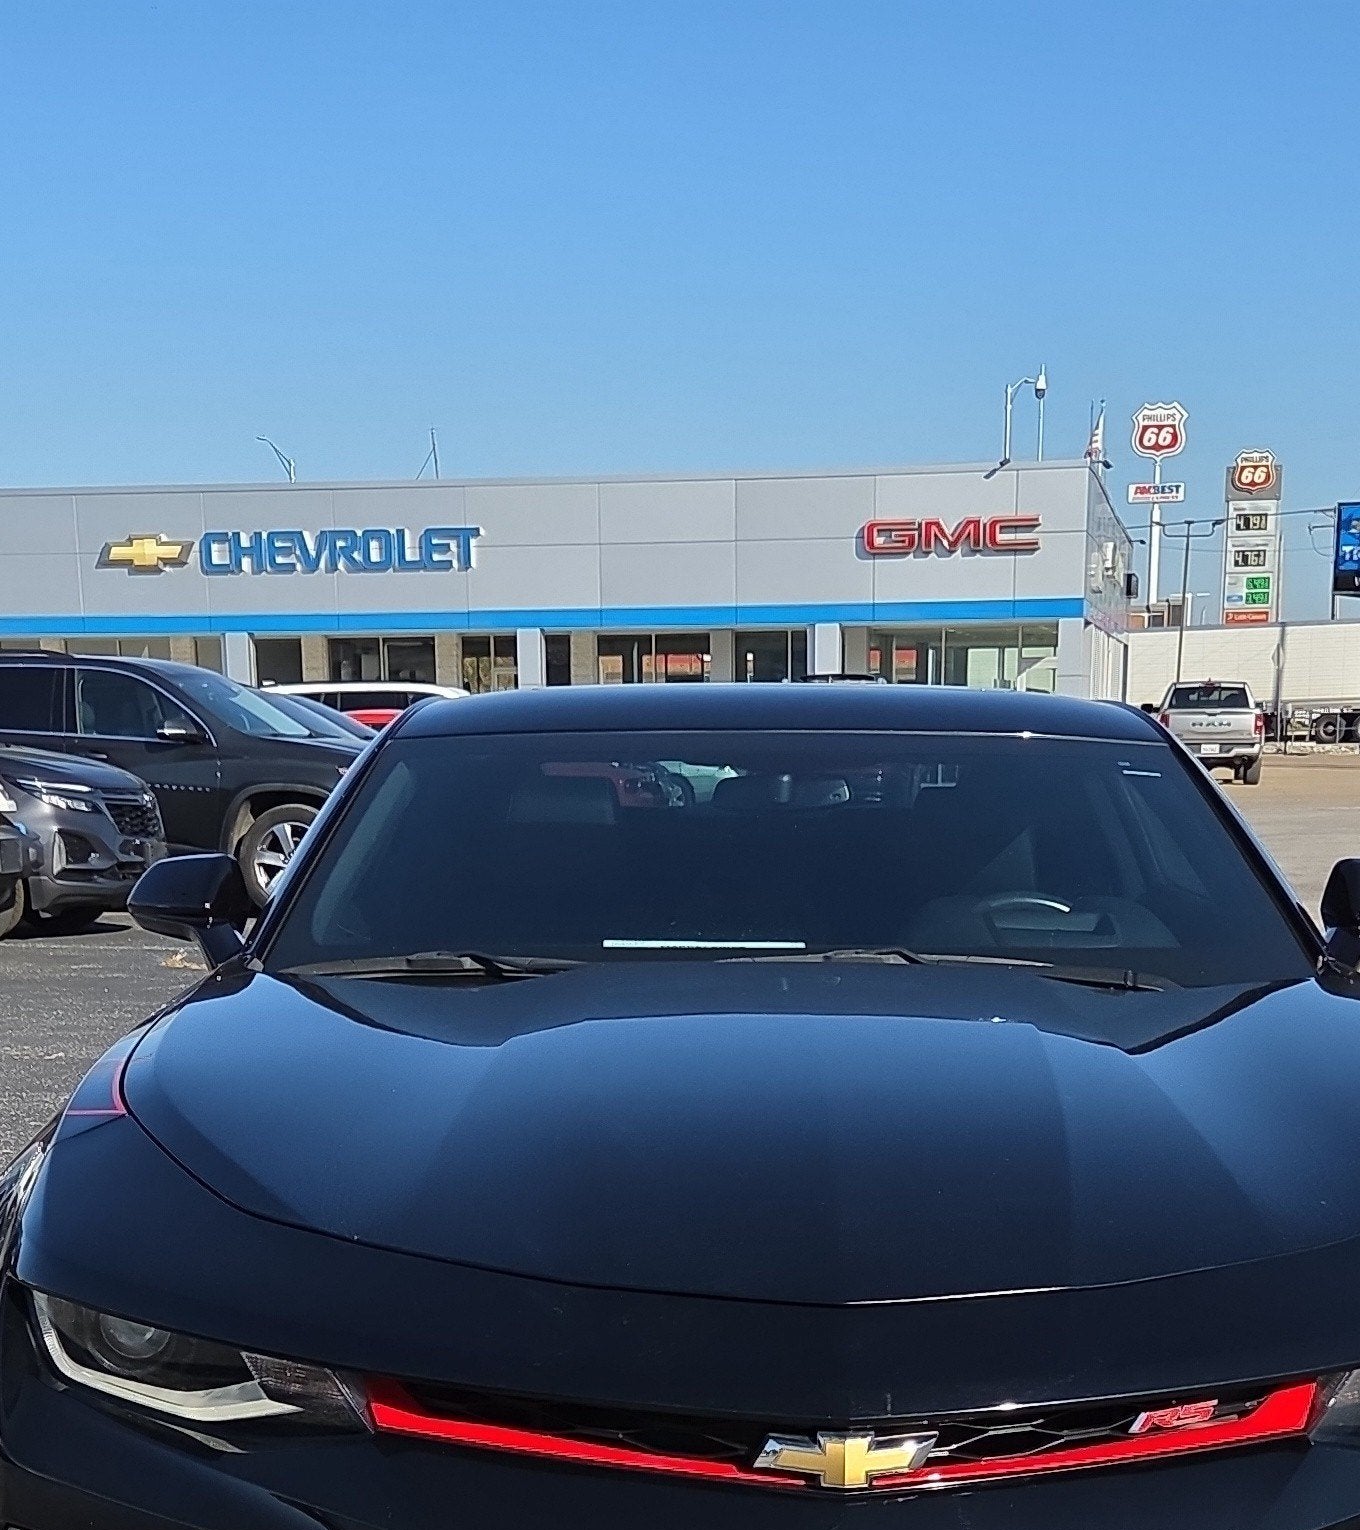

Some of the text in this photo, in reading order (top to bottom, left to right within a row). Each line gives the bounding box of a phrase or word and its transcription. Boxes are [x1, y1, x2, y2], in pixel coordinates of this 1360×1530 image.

[1142, 413, 1177, 423] PHILLIPS
[1142, 427, 1174, 447] 66
[1241, 467, 1268, 483] 66
[862, 514, 1042, 554] GMC
[200, 526, 482, 577] CHEVROLET
[1128, 1399, 1219, 1434] RS
